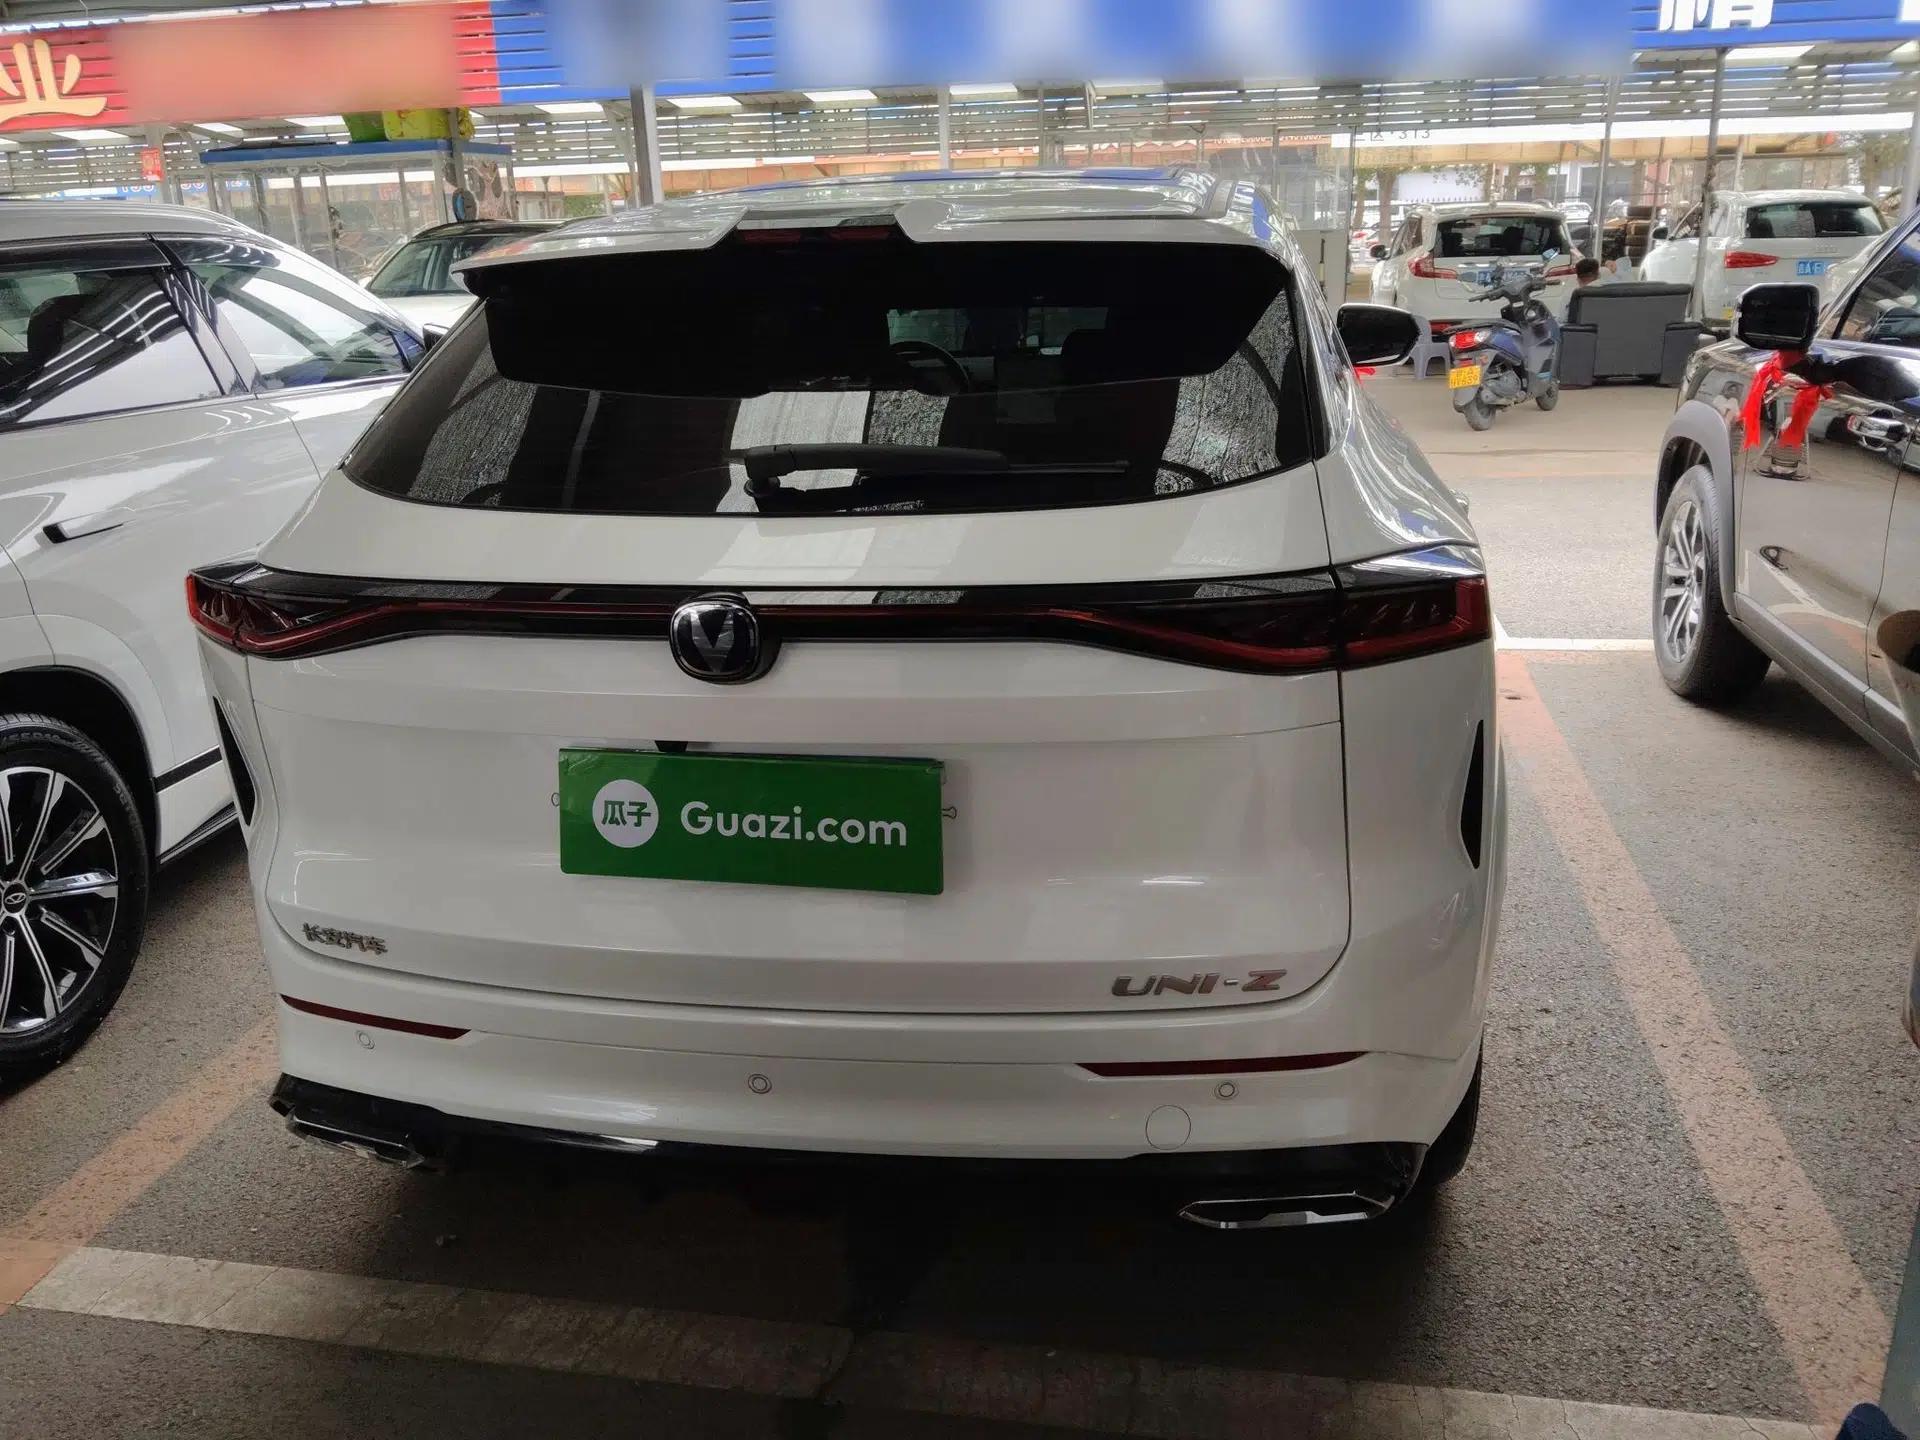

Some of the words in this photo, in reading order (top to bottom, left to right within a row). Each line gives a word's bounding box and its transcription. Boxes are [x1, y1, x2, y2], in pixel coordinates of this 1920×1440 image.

[601, 800, 652, 828] 瓜子
[680, 801, 907, 847] Guazi.com
[1111, 968, 1288, 997] UNI-Z
